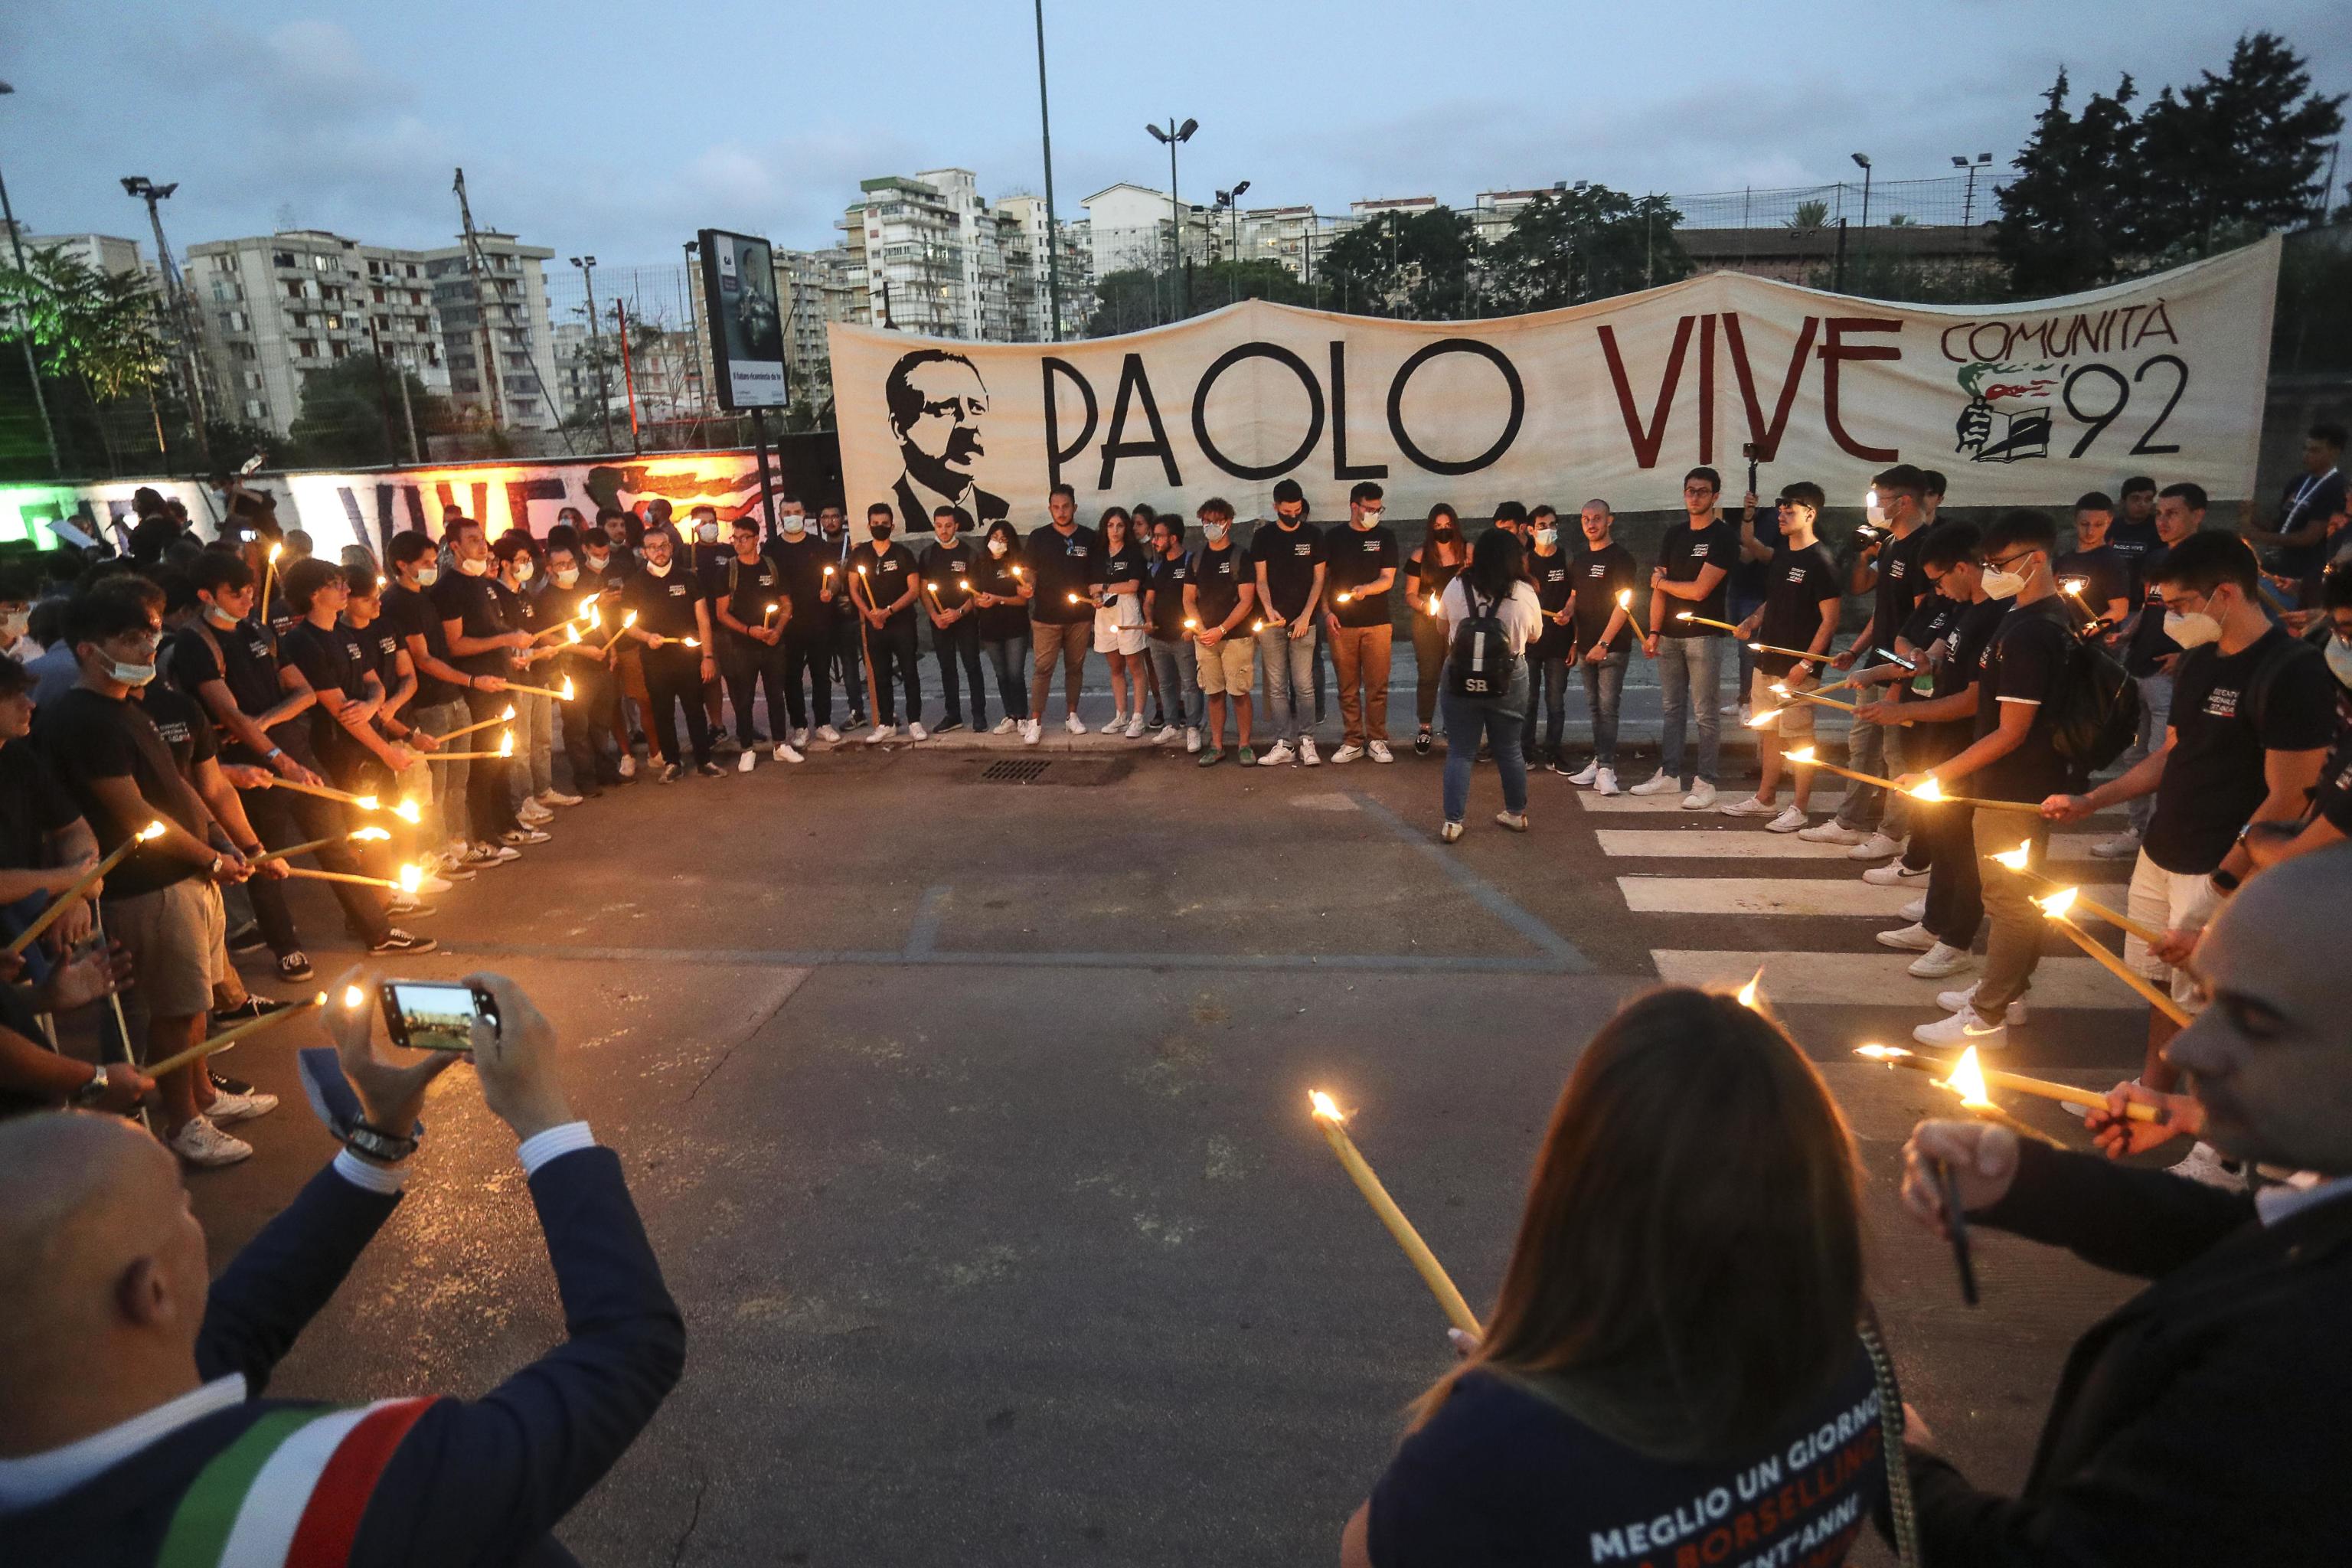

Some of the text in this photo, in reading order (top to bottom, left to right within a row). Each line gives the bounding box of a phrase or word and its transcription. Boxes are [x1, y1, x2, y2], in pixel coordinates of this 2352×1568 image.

[1941, 297, 2178, 362] COMUNITÀ
[1042, 312, 1903, 491] PAOLO VIVE
[2060, 354, 2188, 459] '92
[1589, 1487, 1731, 1563] MEGLIO
[1736, 1455, 1782, 1501] UN
